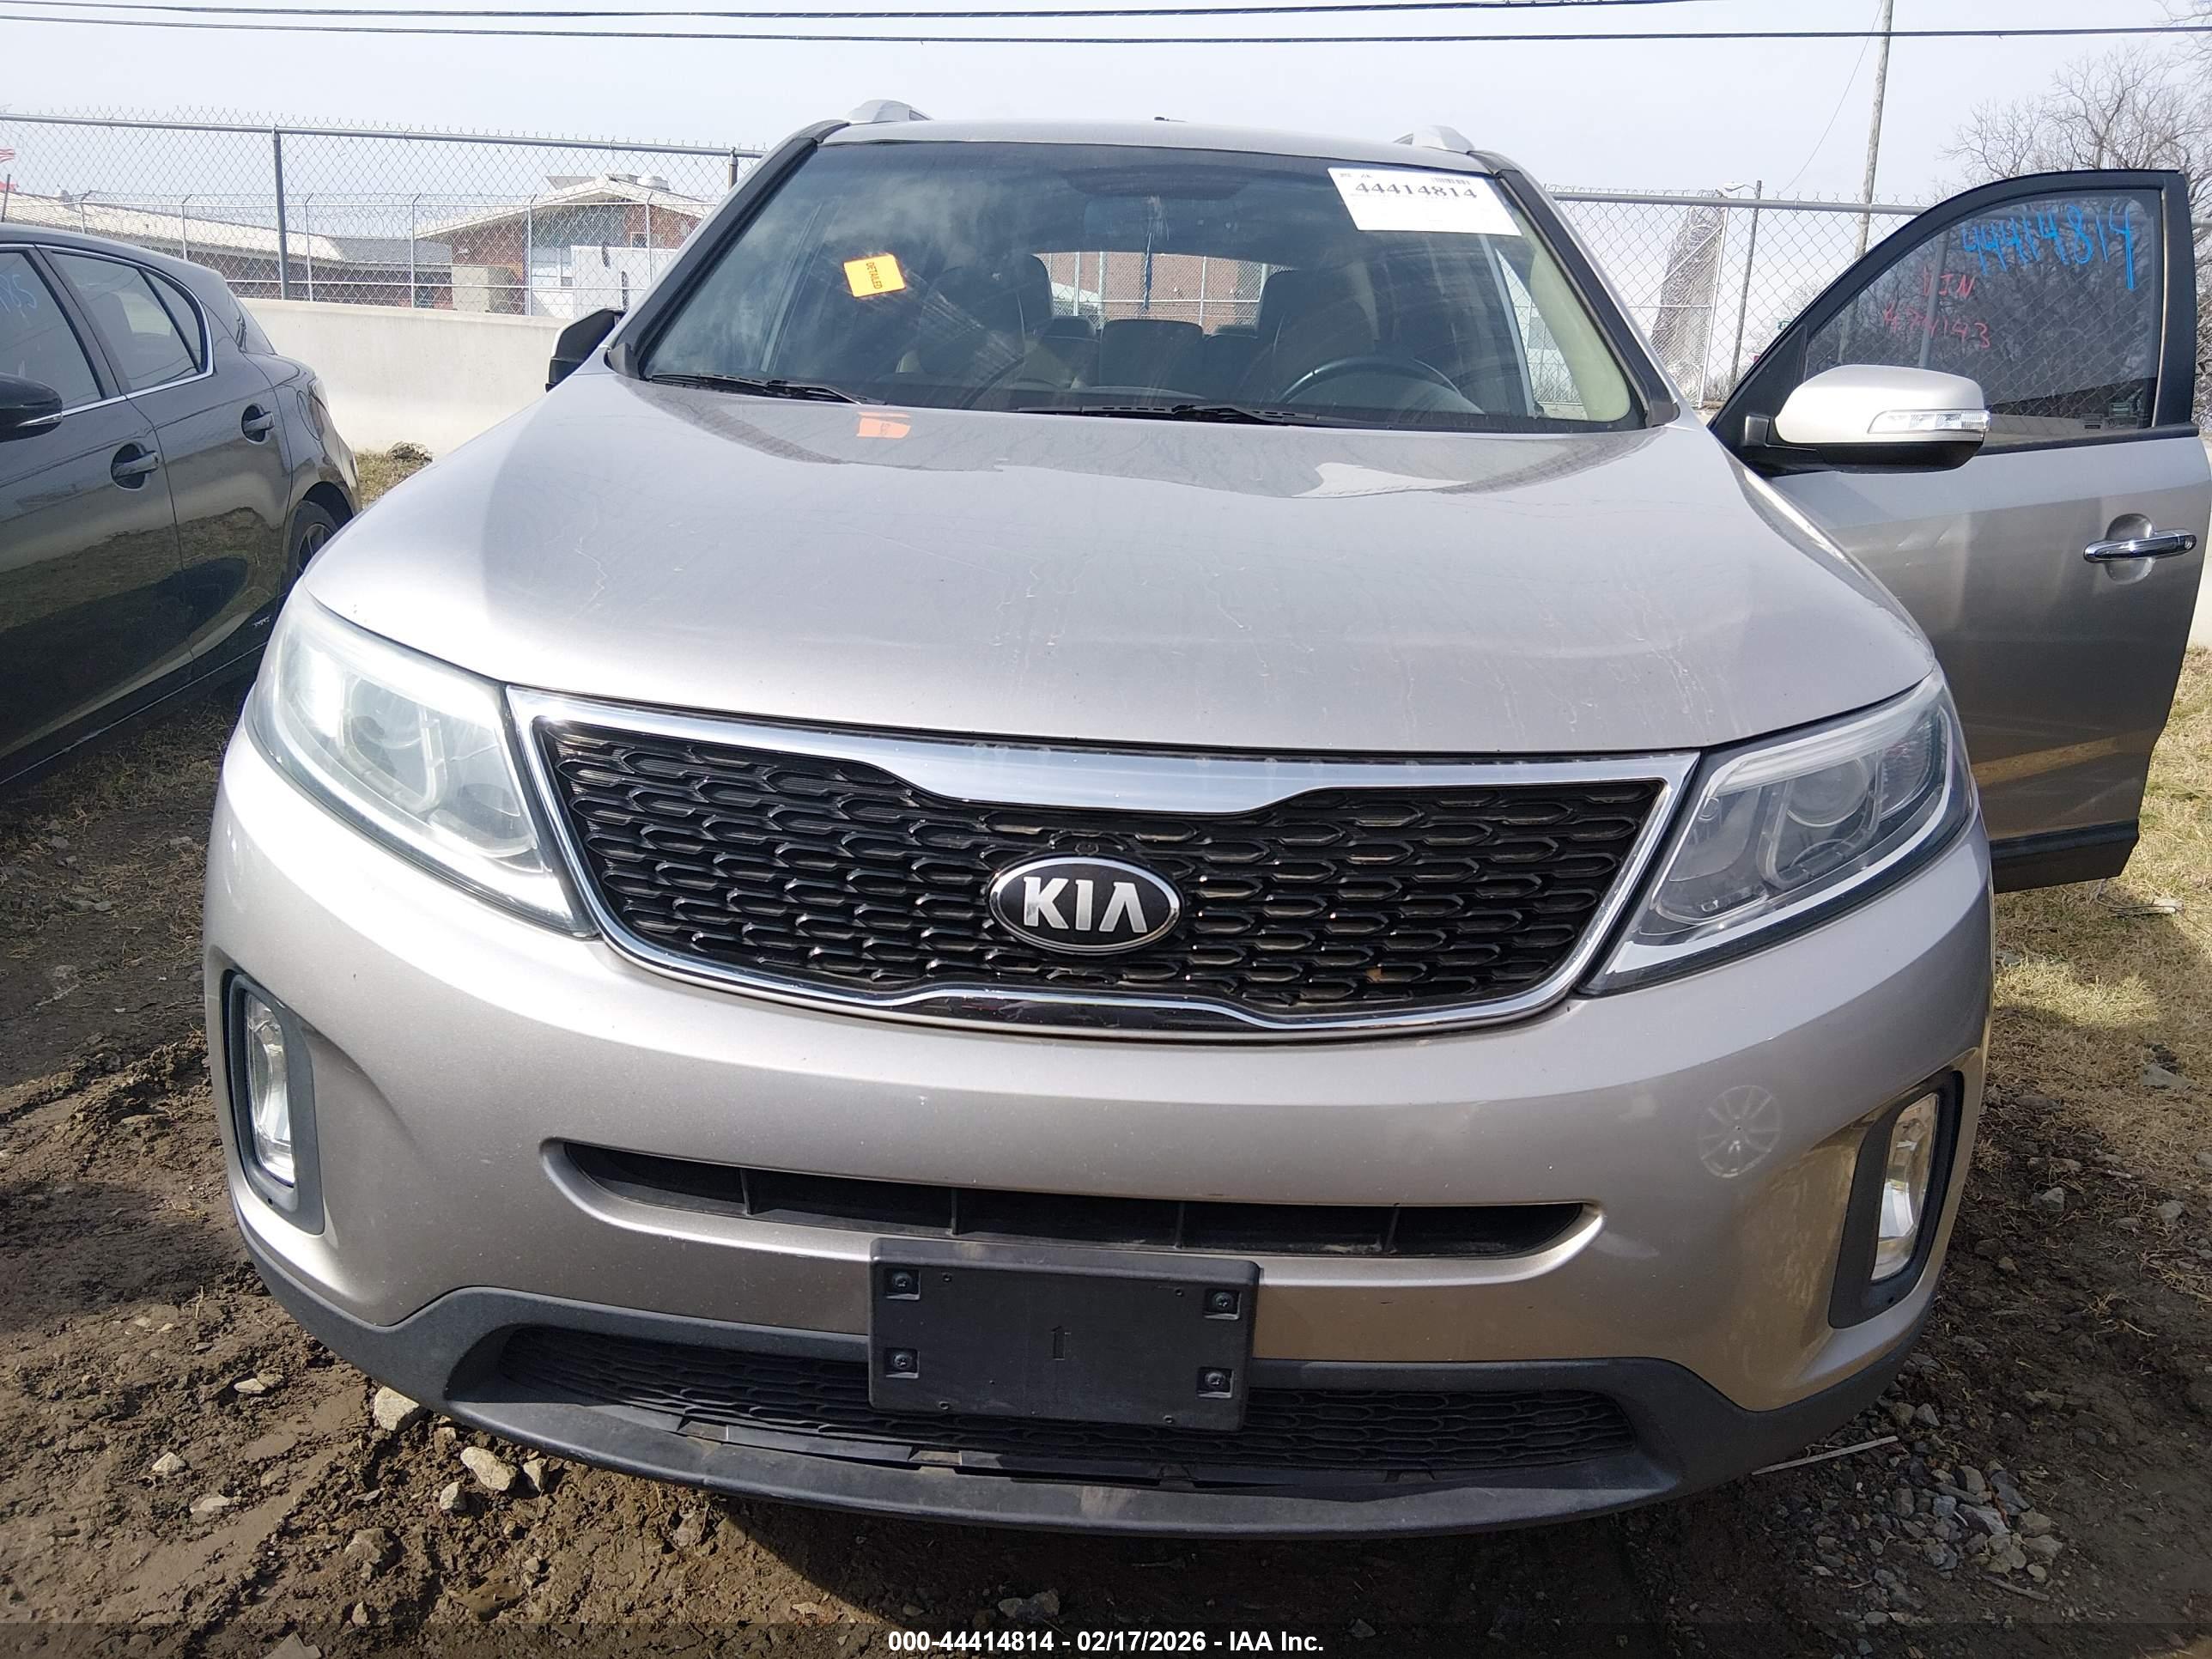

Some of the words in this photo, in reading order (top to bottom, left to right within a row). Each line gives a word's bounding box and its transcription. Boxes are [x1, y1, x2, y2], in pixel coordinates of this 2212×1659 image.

[1355, 182, 1478, 199] 44414814
[1961, 204, 2136, 291] 44414814
[866, 261, 883, 289] DETAILED
[1023, 877, 1148, 933] KIA
